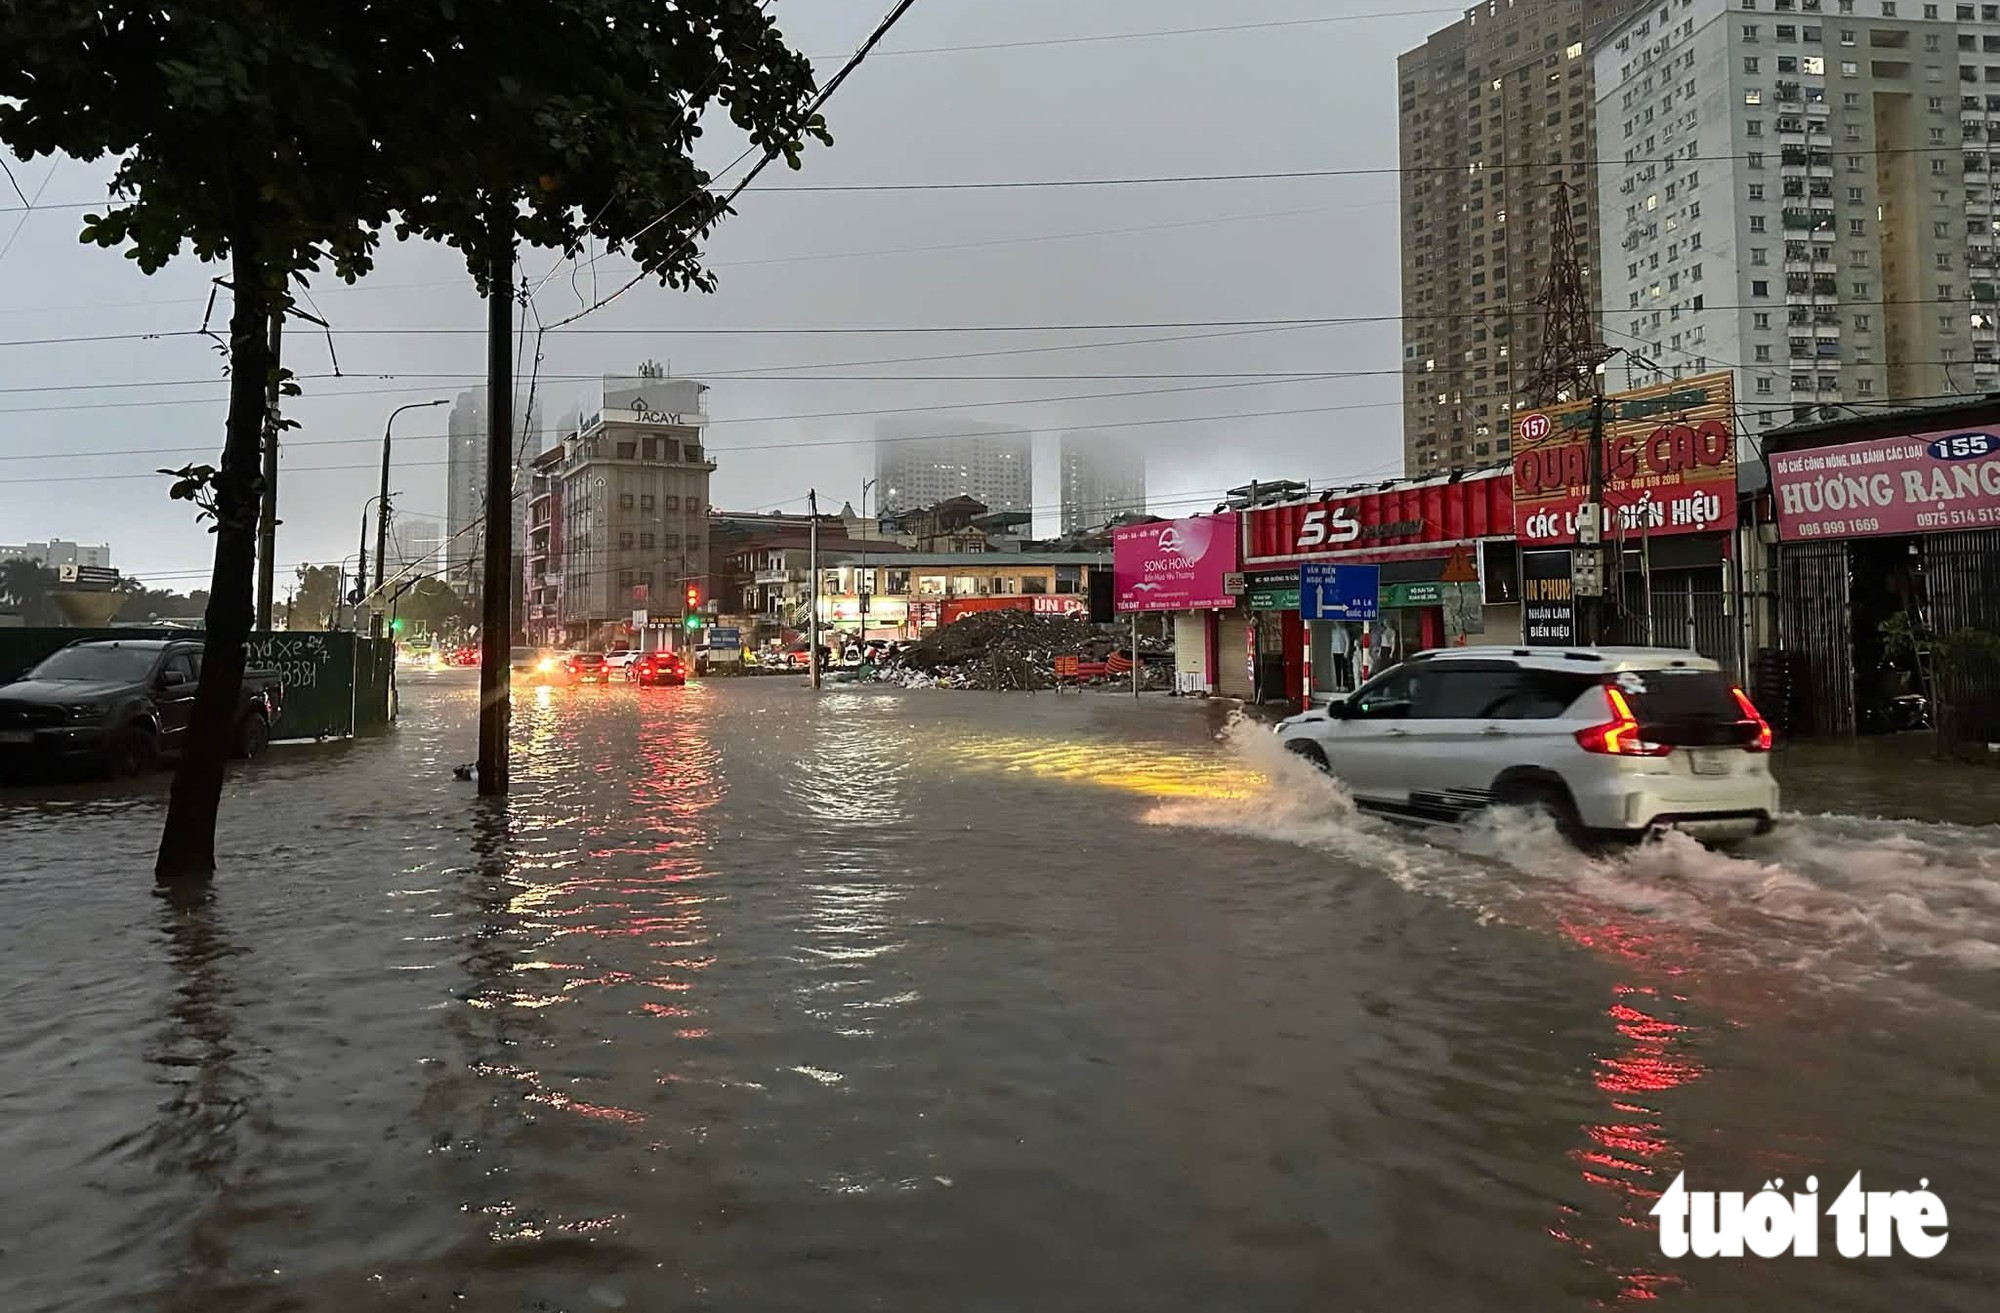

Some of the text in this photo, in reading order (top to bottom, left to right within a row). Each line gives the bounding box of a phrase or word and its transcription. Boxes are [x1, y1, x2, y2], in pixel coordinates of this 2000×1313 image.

[633, 404, 684, 424] JACAYL
[1523, 418, 1545, 437] 157
[1851, 453, 1862, 466] BA
[1863, 449, 1885, 465] BÁNH
[1886, 446, 1902, 461] CÁC
[1904, 444, 1923, 461] LOẠI
[1935, 435, 1988, 458] 155
[1780, 461, 2000, 515] HƯƠNG RẠNG
[1526, 490, 1719, 539] CÁC LI BIỂN HIỆU
[1917, 511, 1948, 527] 0975
[1951, 509, 1975, 525] 514
[1297, 507, 1360, 546] 5S
[1823, 519, 1845, 534] 999
[1526, 578, 1571, 601] IN PHUN
[1528, 605, 1571, 622] NHẬN LÀM
[1530, 622, 1570, 639] BIỂN HIỆU
